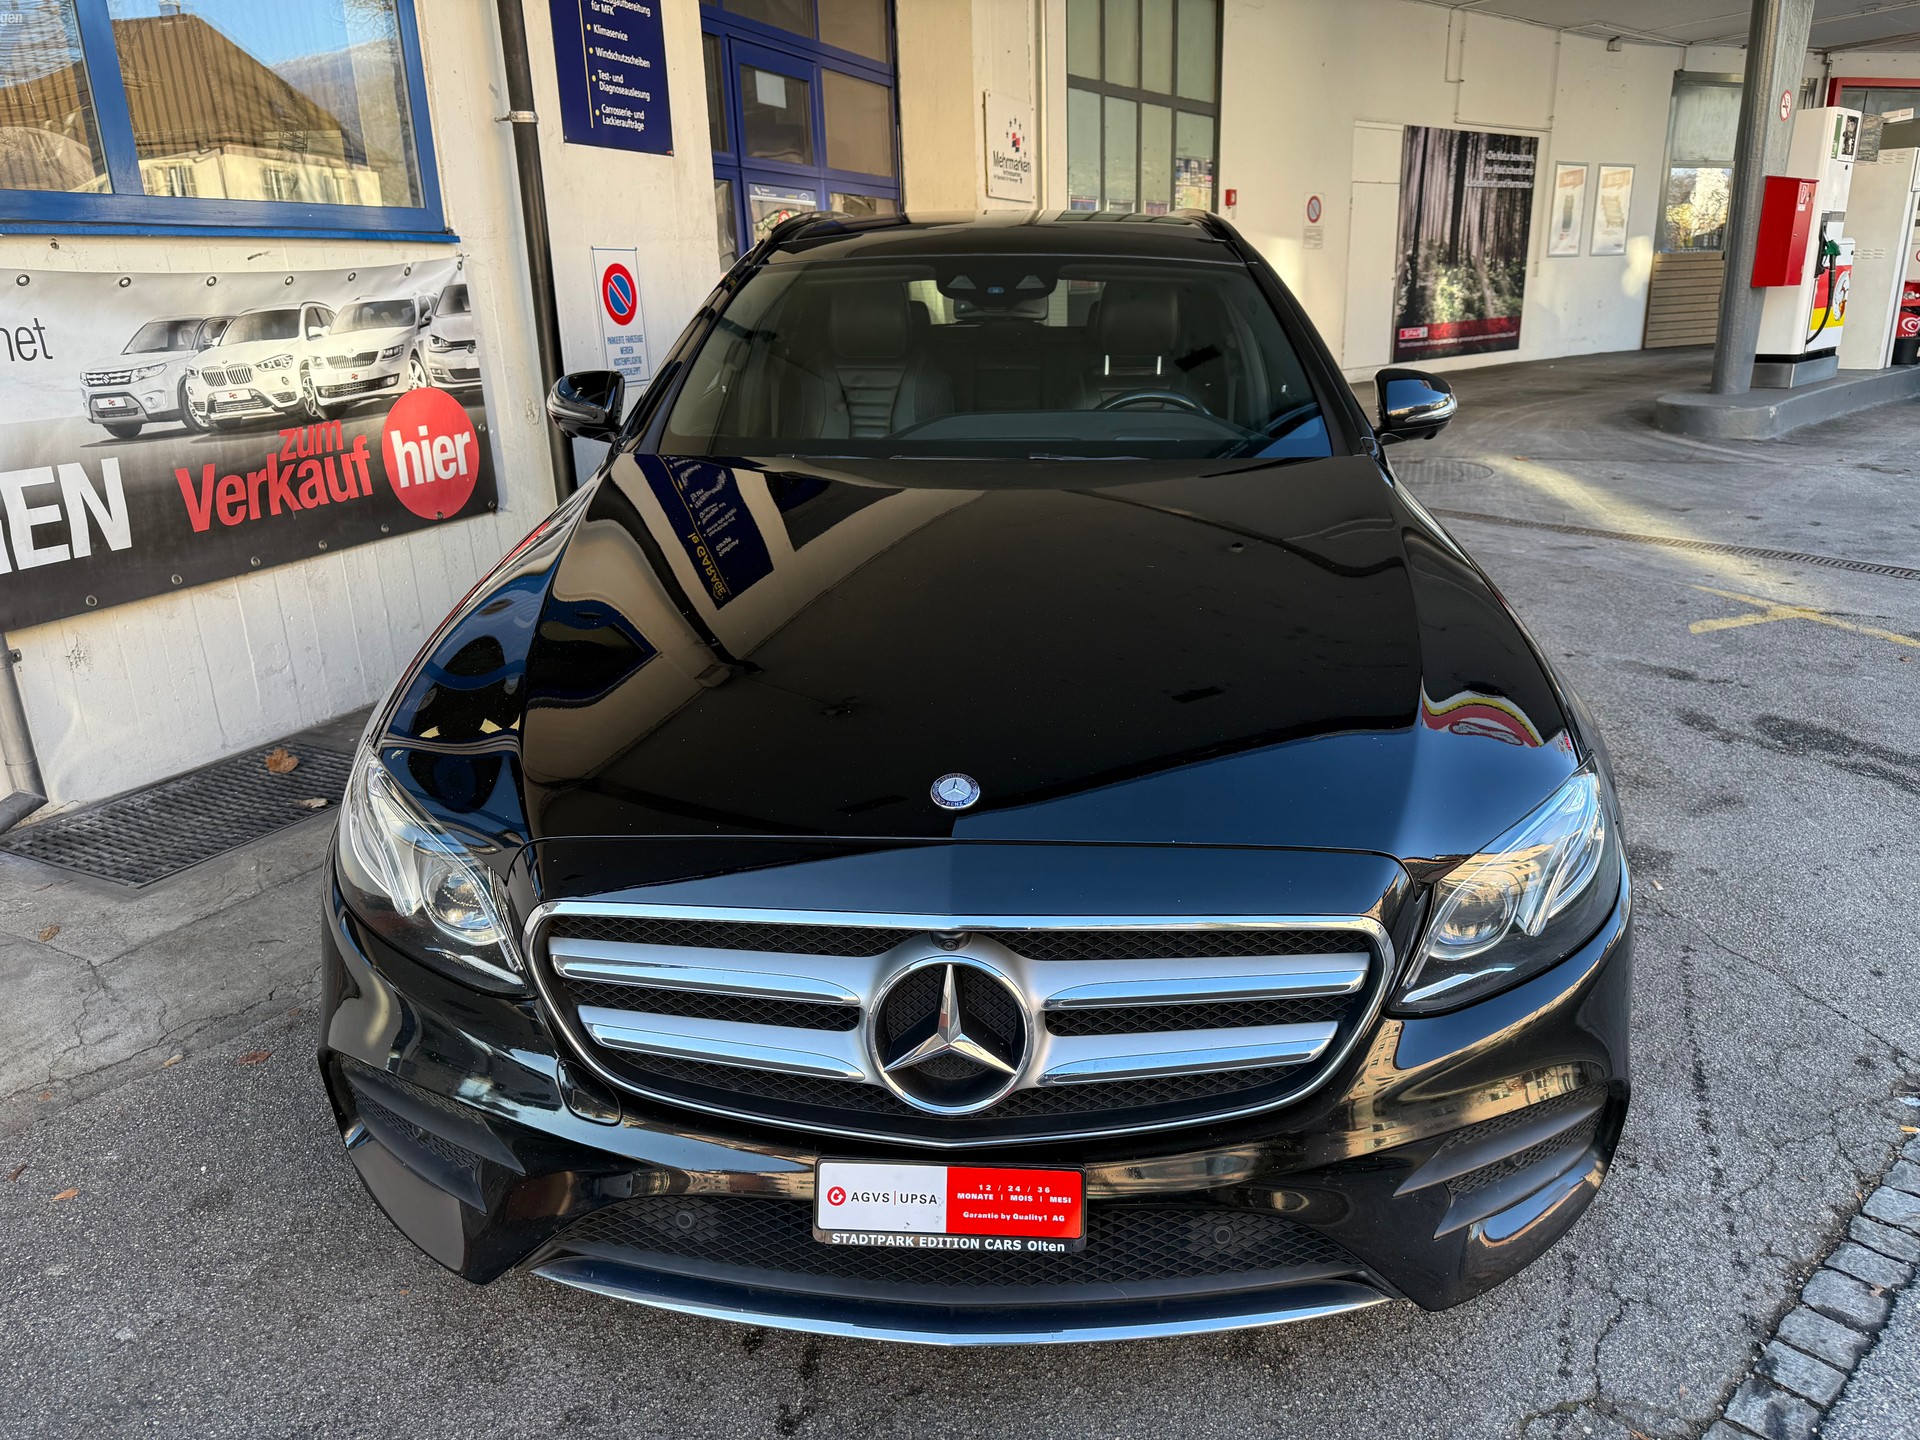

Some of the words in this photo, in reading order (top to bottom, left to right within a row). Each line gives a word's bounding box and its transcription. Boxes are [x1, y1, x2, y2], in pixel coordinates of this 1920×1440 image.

[601, 3, 615, 16] MFK
[593, 24, 628, 41] Klimaservice
[595, 46, 651, 68] Windschutzscheiben
[597, 69, 611, 81] Test-
[612, 74, 624, 83] und
[599, 81, 651, 102] Diagnoseauslesung
[601, 103, 633, 118] Carrosserie-
[634, 110, 645, 119] und
[602, 115, 645, 132] Lackieraufträge
[279, 419, 344, 461] zum
[174, 435, 373, 533] Verkauf
[390, 425, 471, 488] hier
[0, 457, 133, 575] EN
[851, 1191, 890, 1203] AGVS
[900, 1193, 938, 1205] UPSA
[957, 1192, 994, 1200] MONATE
[1010, 1194, 1033, 1202] MOIS
[1049, 1196, 1071, 1204] MESI
[963, 1211, 998, 1219] Garantie
[1001, 1212, 1011, 1220] by
[1012, 1213, 1047, 1222] Quality1
[832, 1233, 914, 1247] STADTPARK
[920, 1236, 979, 1249] EDITION
[984, 1239, 1021, 1250] CARS
[1027, 1240, 1065, 1252] Olten
